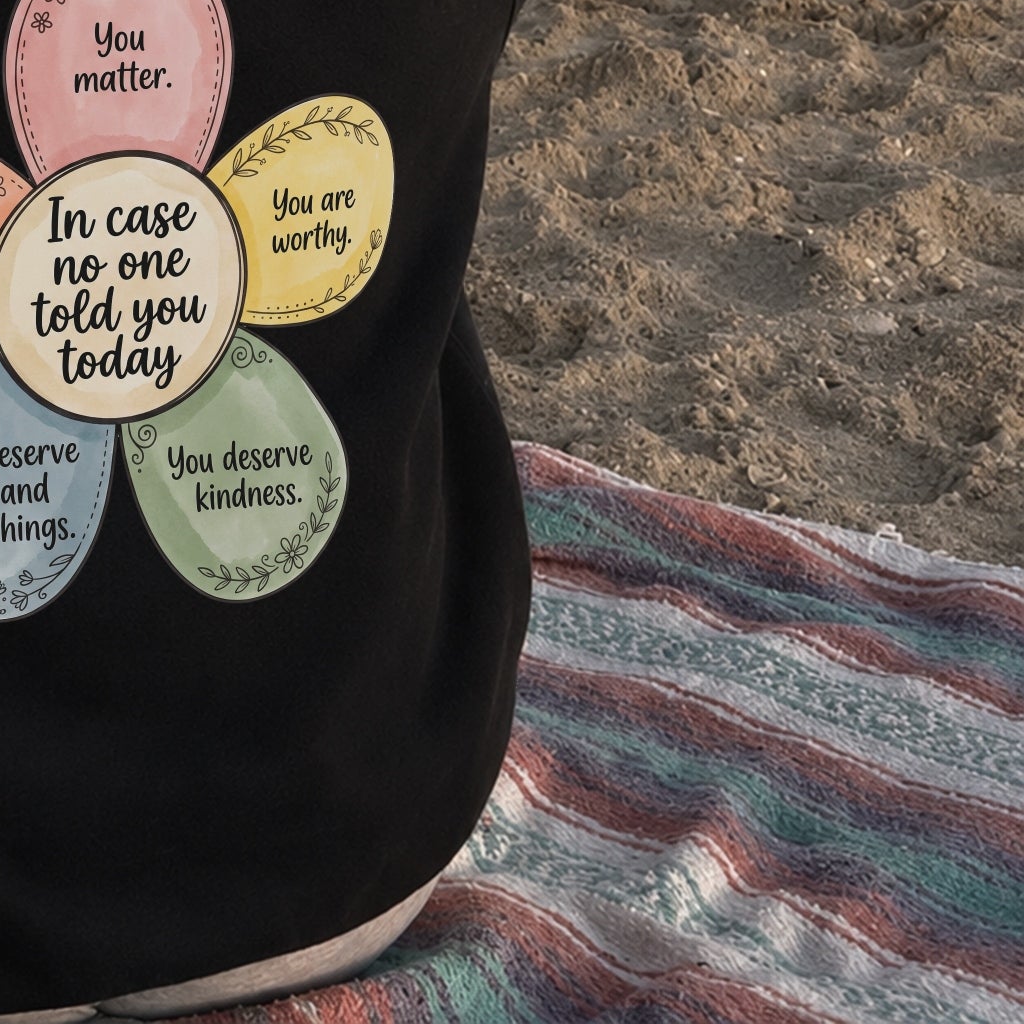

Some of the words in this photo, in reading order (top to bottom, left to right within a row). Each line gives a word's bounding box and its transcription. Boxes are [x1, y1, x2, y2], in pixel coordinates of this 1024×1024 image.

[95, 22, 144, 57] You
[75, 61, 171, 93] matter.
[48, 196, 95, 242] In
[107, 202, 196, 238] case
[273, 188, 312, 221] You
[322, 190, 355, 211] are
[273, 220, 351, 255] worthy.
[54, 255, 107, 285] no
[119, 248, 190, 280] one
[31, 286, 121, 337] told
[133, 295, 206, 342] you
[57, 334, 181, 389] today
[168, 445, 213, 480] You
[223, 441, 313, 471] deserve
[1, 472, 49, 505] and
[196, 478, 302, 512] kindness.
